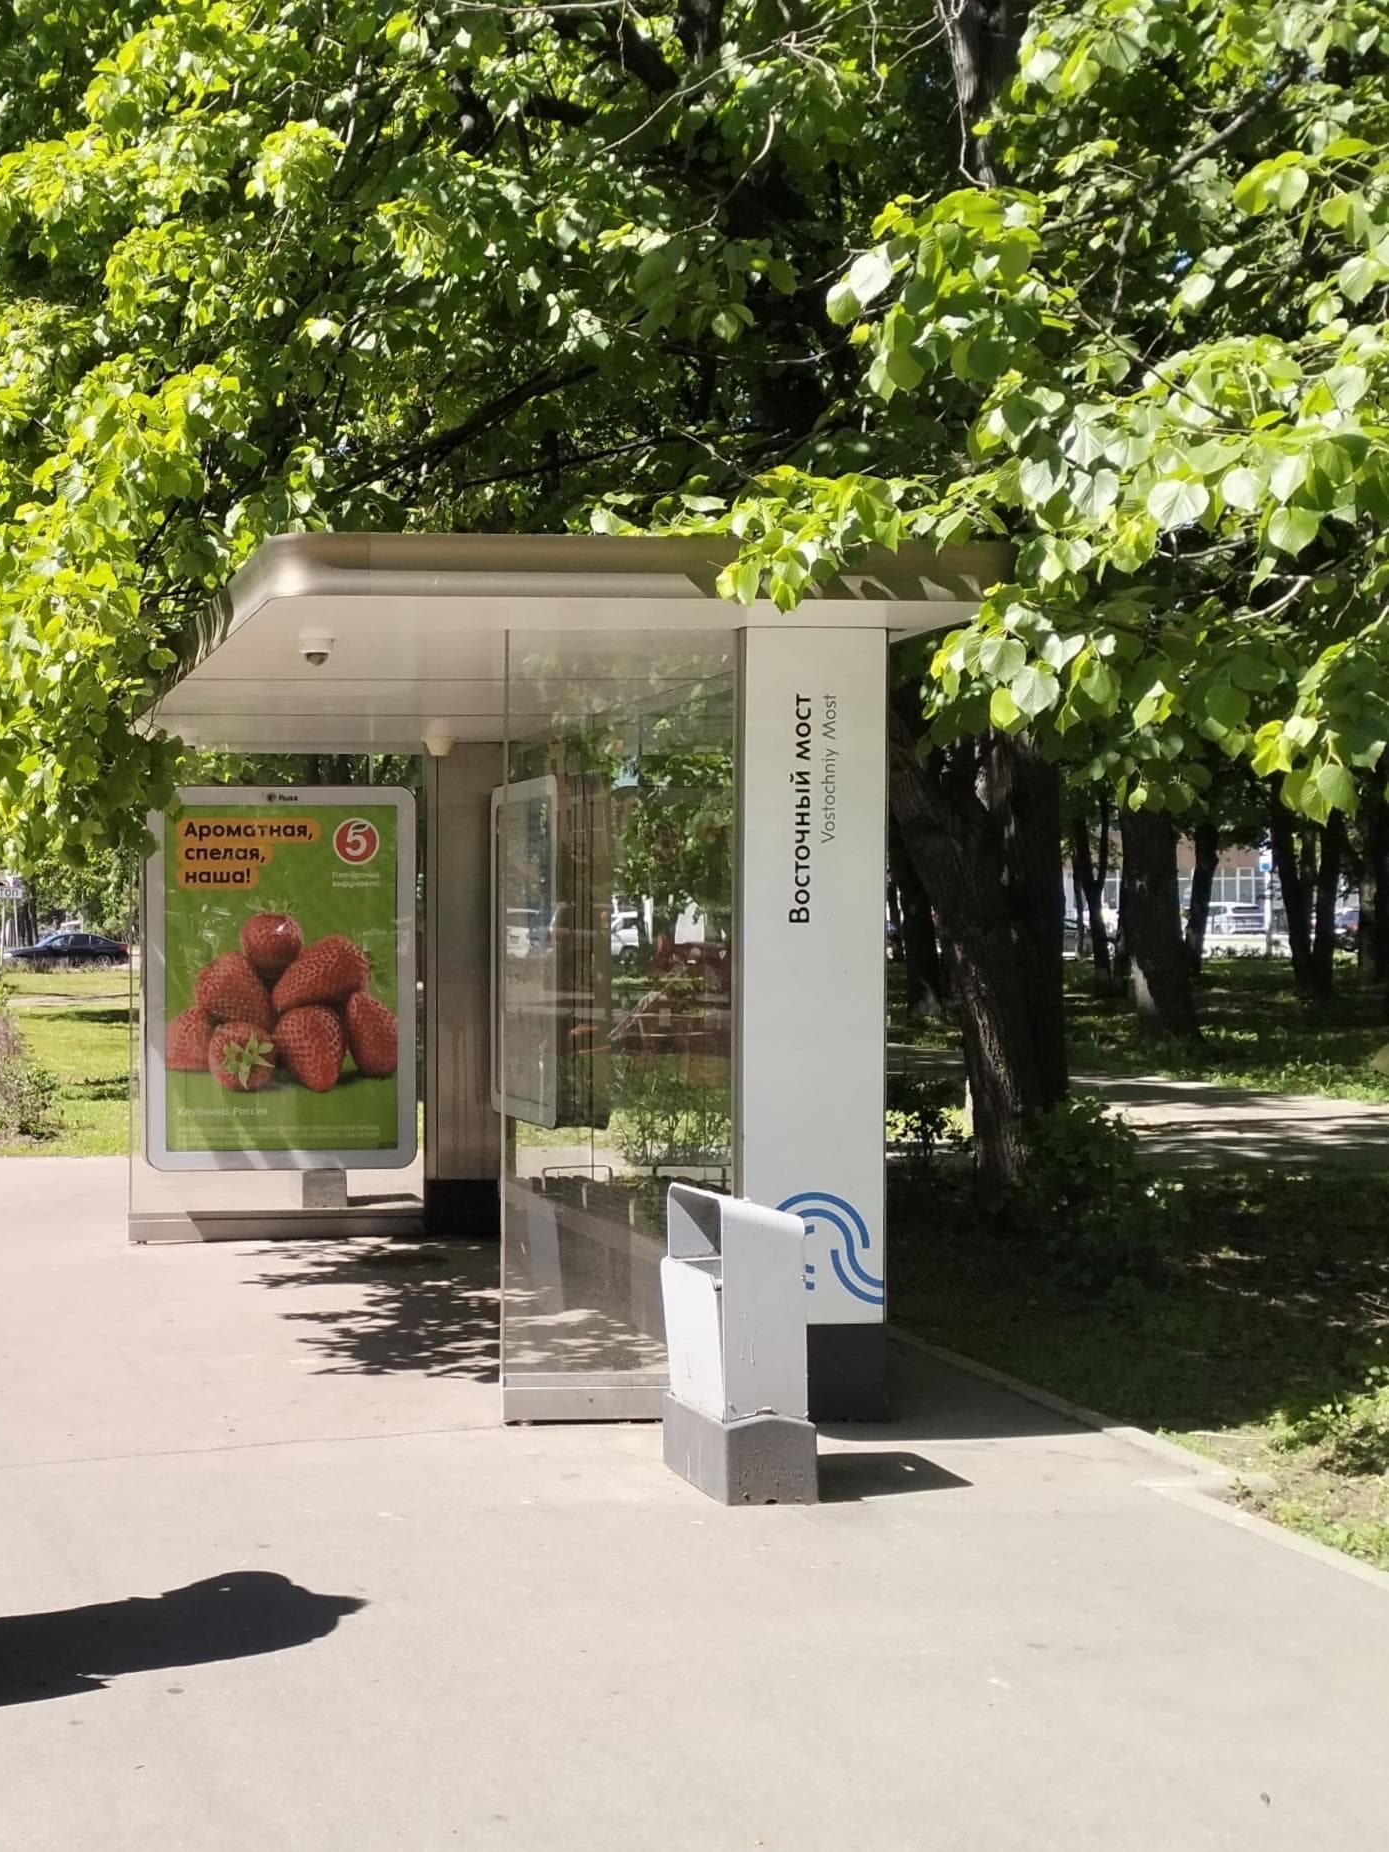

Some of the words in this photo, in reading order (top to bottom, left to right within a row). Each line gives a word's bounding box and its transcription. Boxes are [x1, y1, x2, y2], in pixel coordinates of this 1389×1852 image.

[795, 693, 812, 761] мост
[821, 693, 837, 740] Most
[278, 794, 298, 802] Russ
[820, 748, 839, 844] Vostochniy
[184, 821, 313, 841] Ароматная,
[345, 822, 372, 857] 5
[788, 771, 812, 924] Восточный
[184, 847, 266, 864] спелая,
[184, 868, 251, 884] наша!
